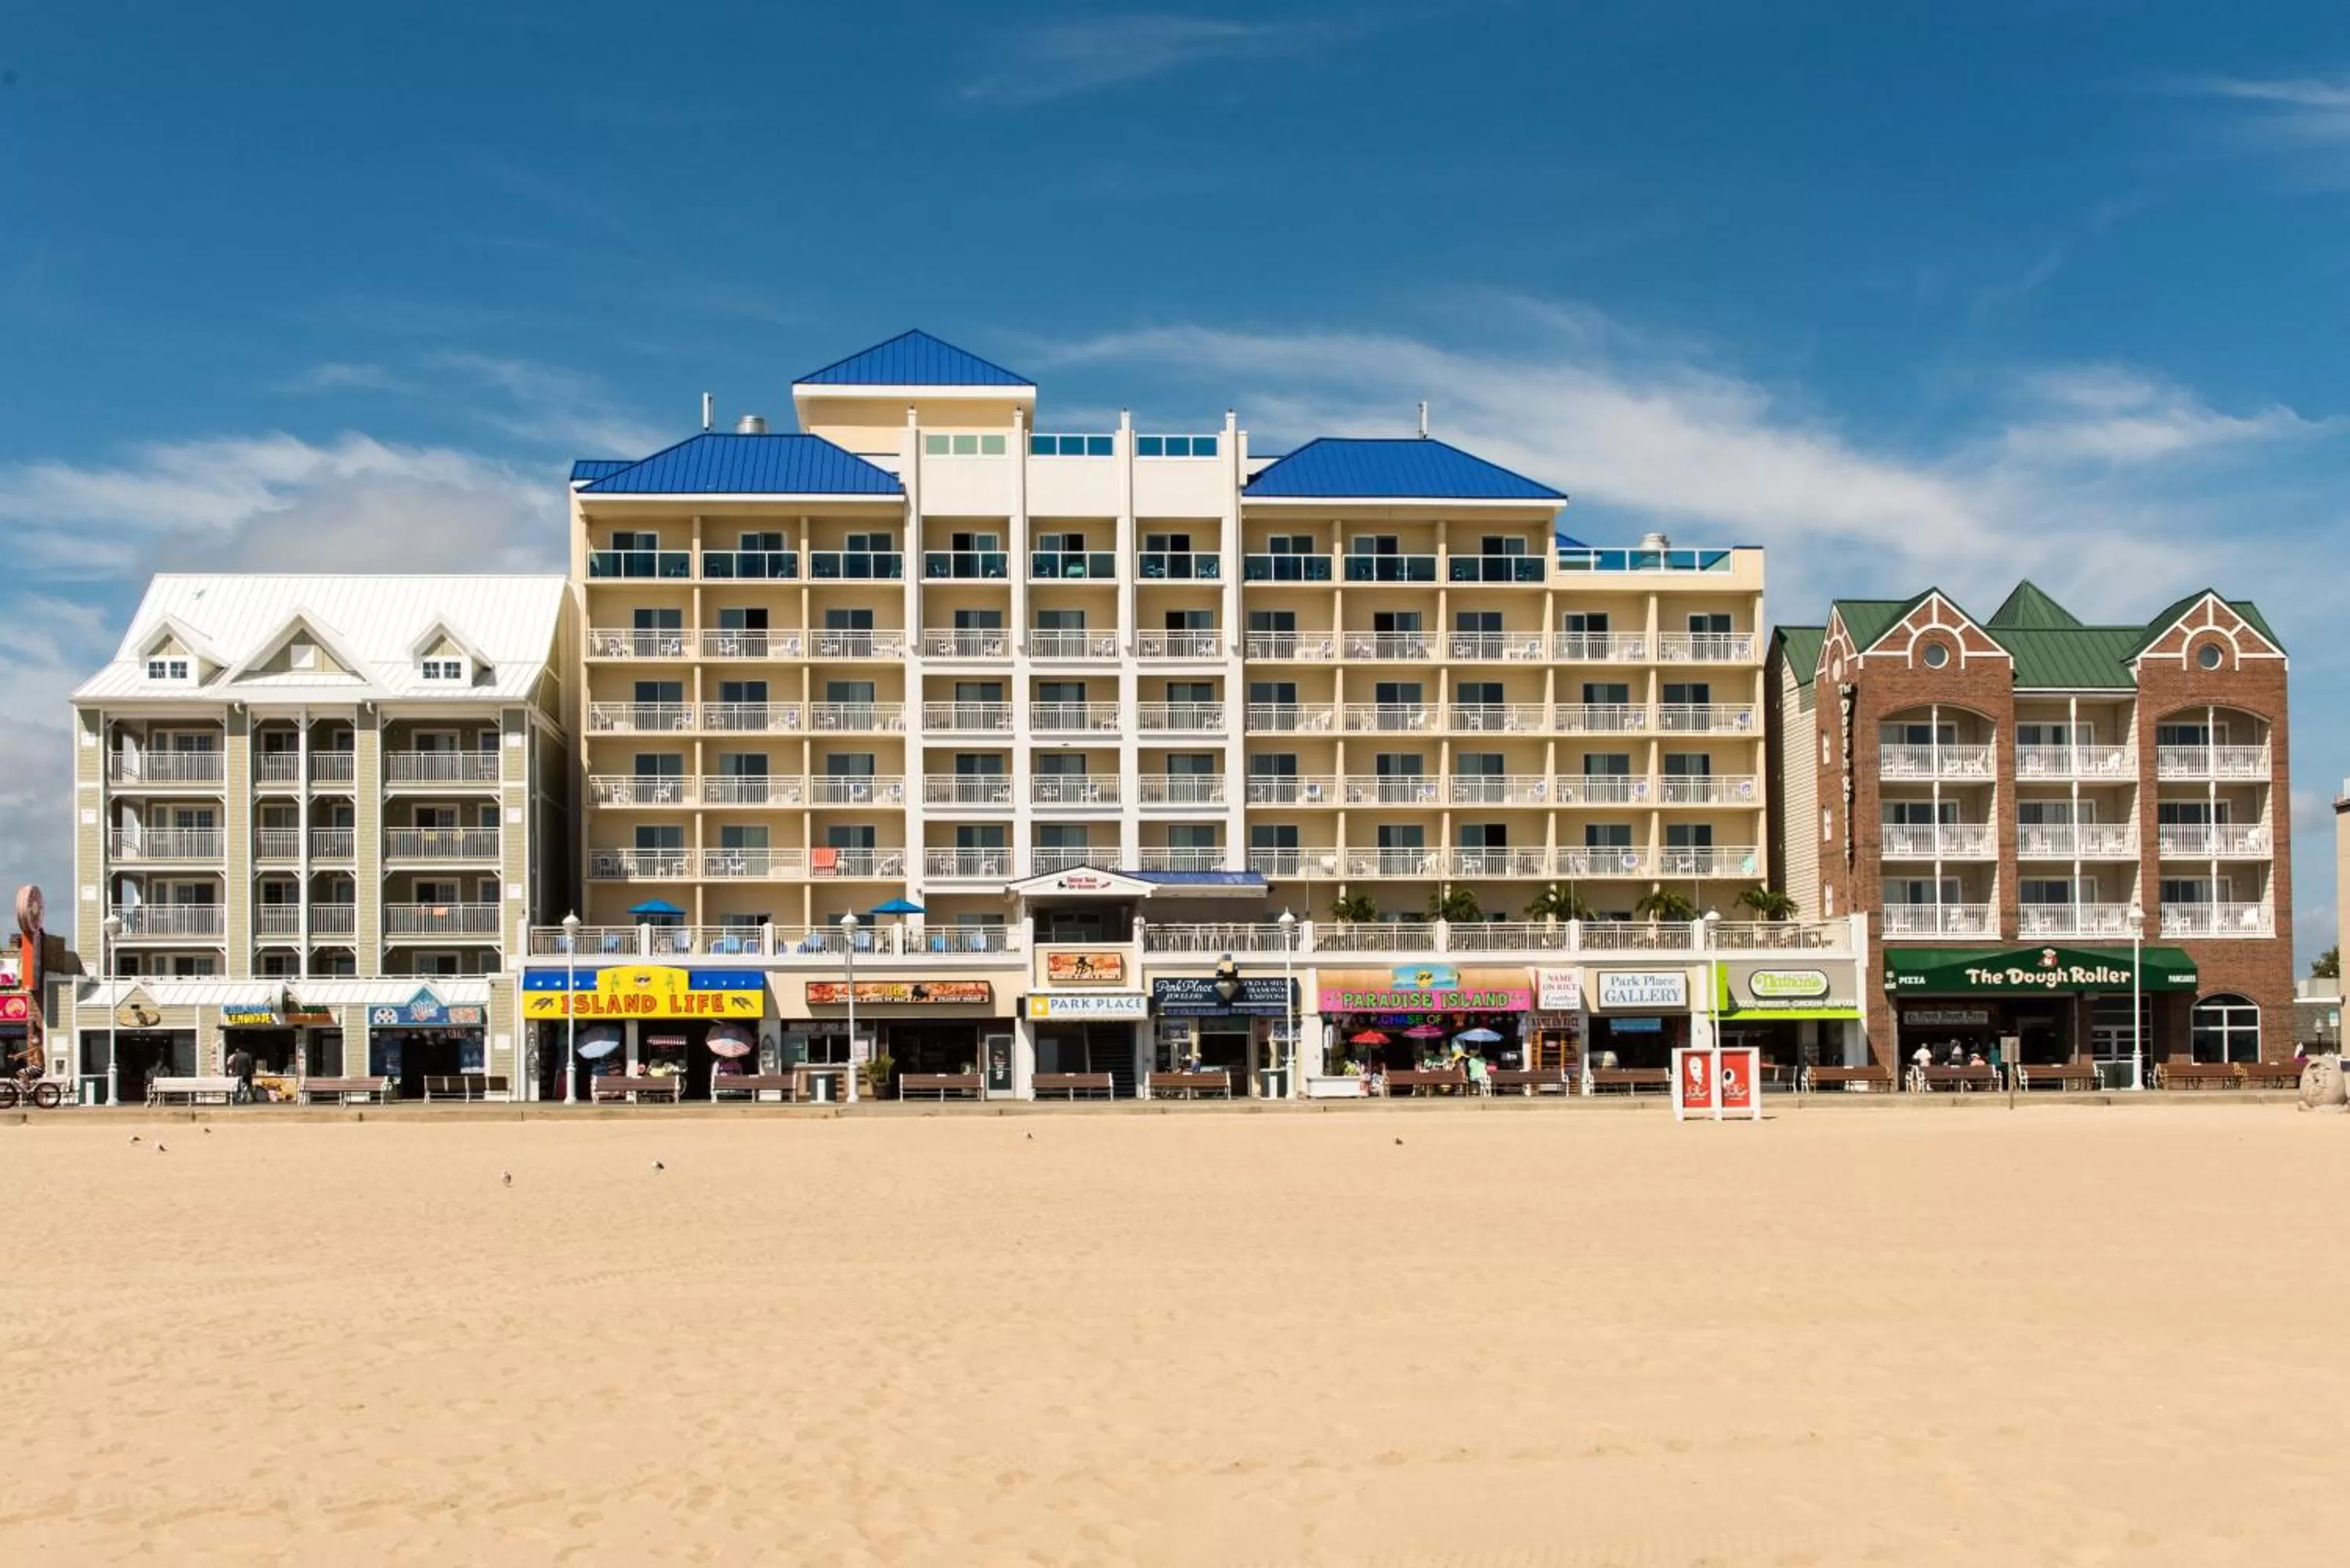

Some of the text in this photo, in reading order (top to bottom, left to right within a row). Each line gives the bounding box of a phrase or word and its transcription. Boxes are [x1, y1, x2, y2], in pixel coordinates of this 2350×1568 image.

[1611, 975, 1676, 986] Park Place
[1898, 976, 1926, 985] PIZZA
[1965, 966, 2131, 988] The Dough Roller
[1155, 980, 1213, 993] Park Place
[1342, 991, 1510, 1009] PARADISE ISLAND
[1604, 988, 1681, 1003] GALLERY
[560, 993, 725, 1014] ISLAND LIFE
[1050, 998, 1142, 1010] PARK PLACE
[225, 1013, 273, 1025] LEMONADE
